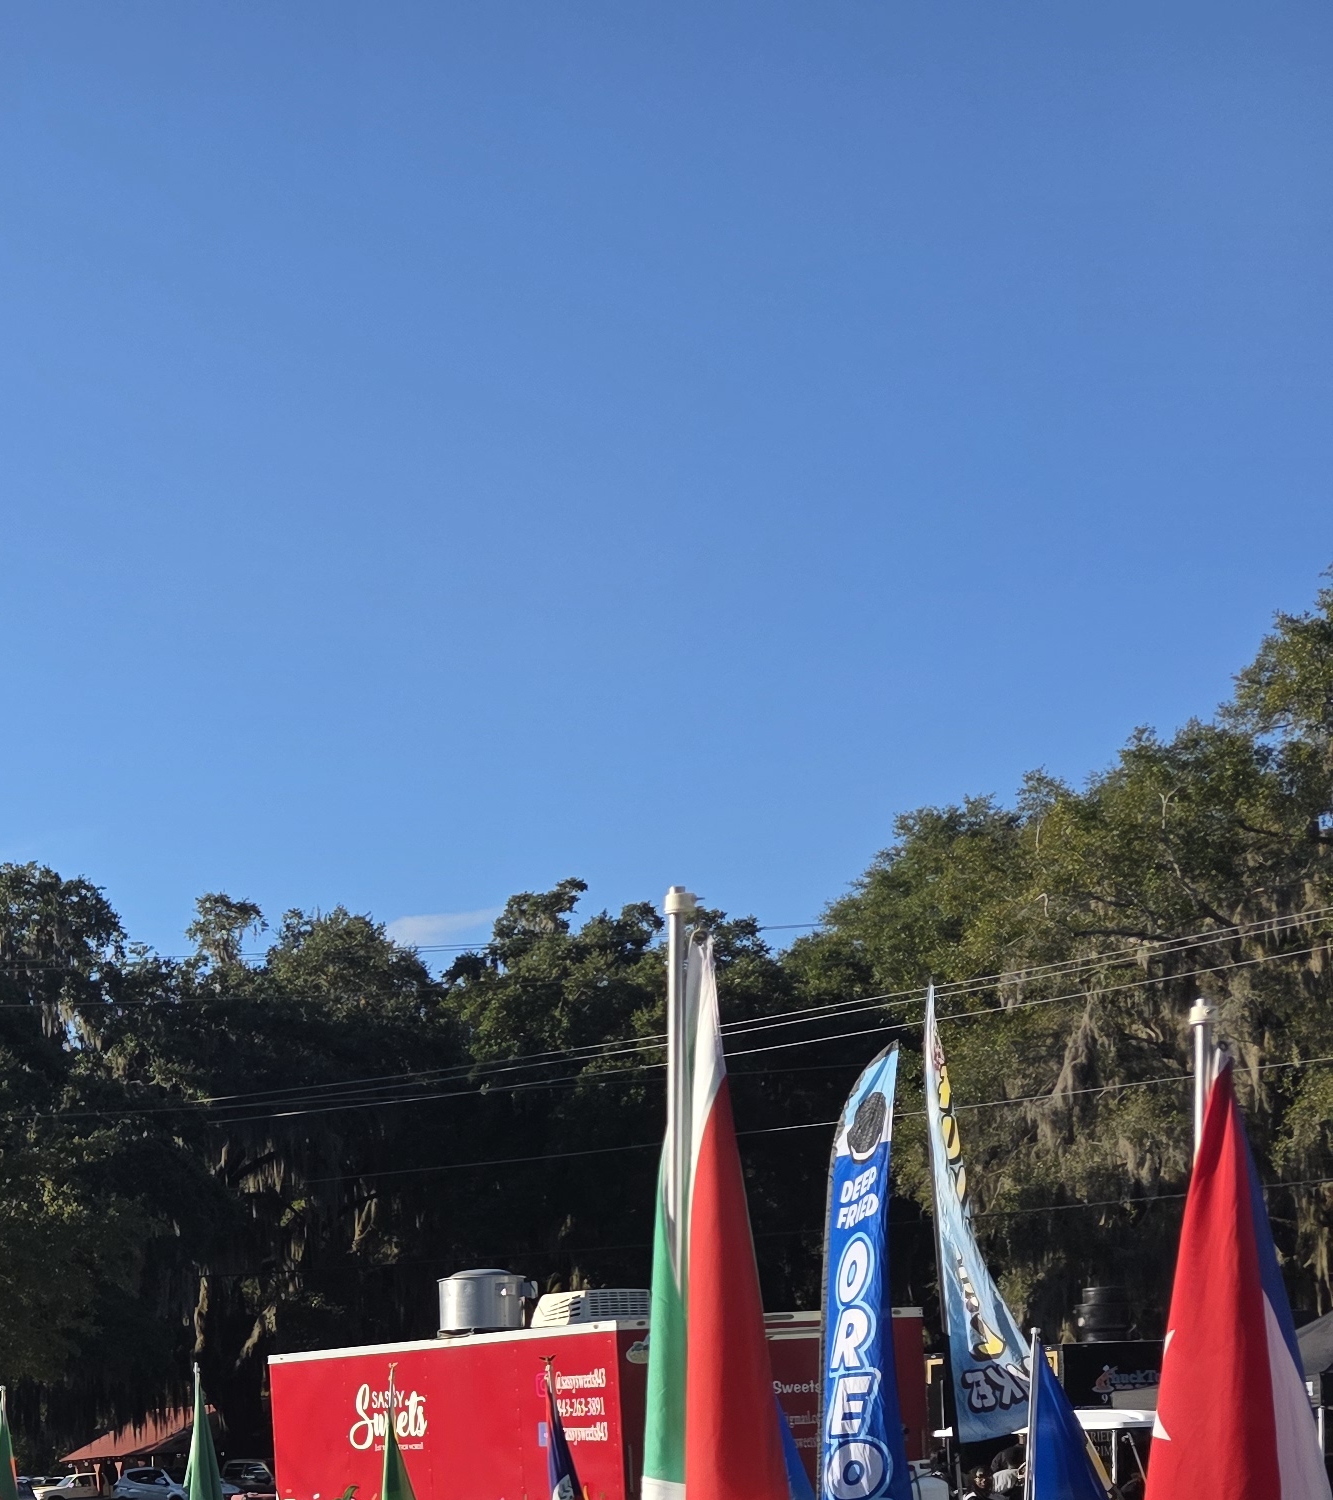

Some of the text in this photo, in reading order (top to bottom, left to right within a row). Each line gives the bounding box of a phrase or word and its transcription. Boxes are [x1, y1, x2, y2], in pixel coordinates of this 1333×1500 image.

[840, 1166, 877, 1204] DEEP
[836, 1193, 879, 1229] FRIED
[773, 1380, 821, 1394] Sweets
[349, 1383, 428, 1450] Swets
[556, 1397, 605, 1417] 843-263-3891
